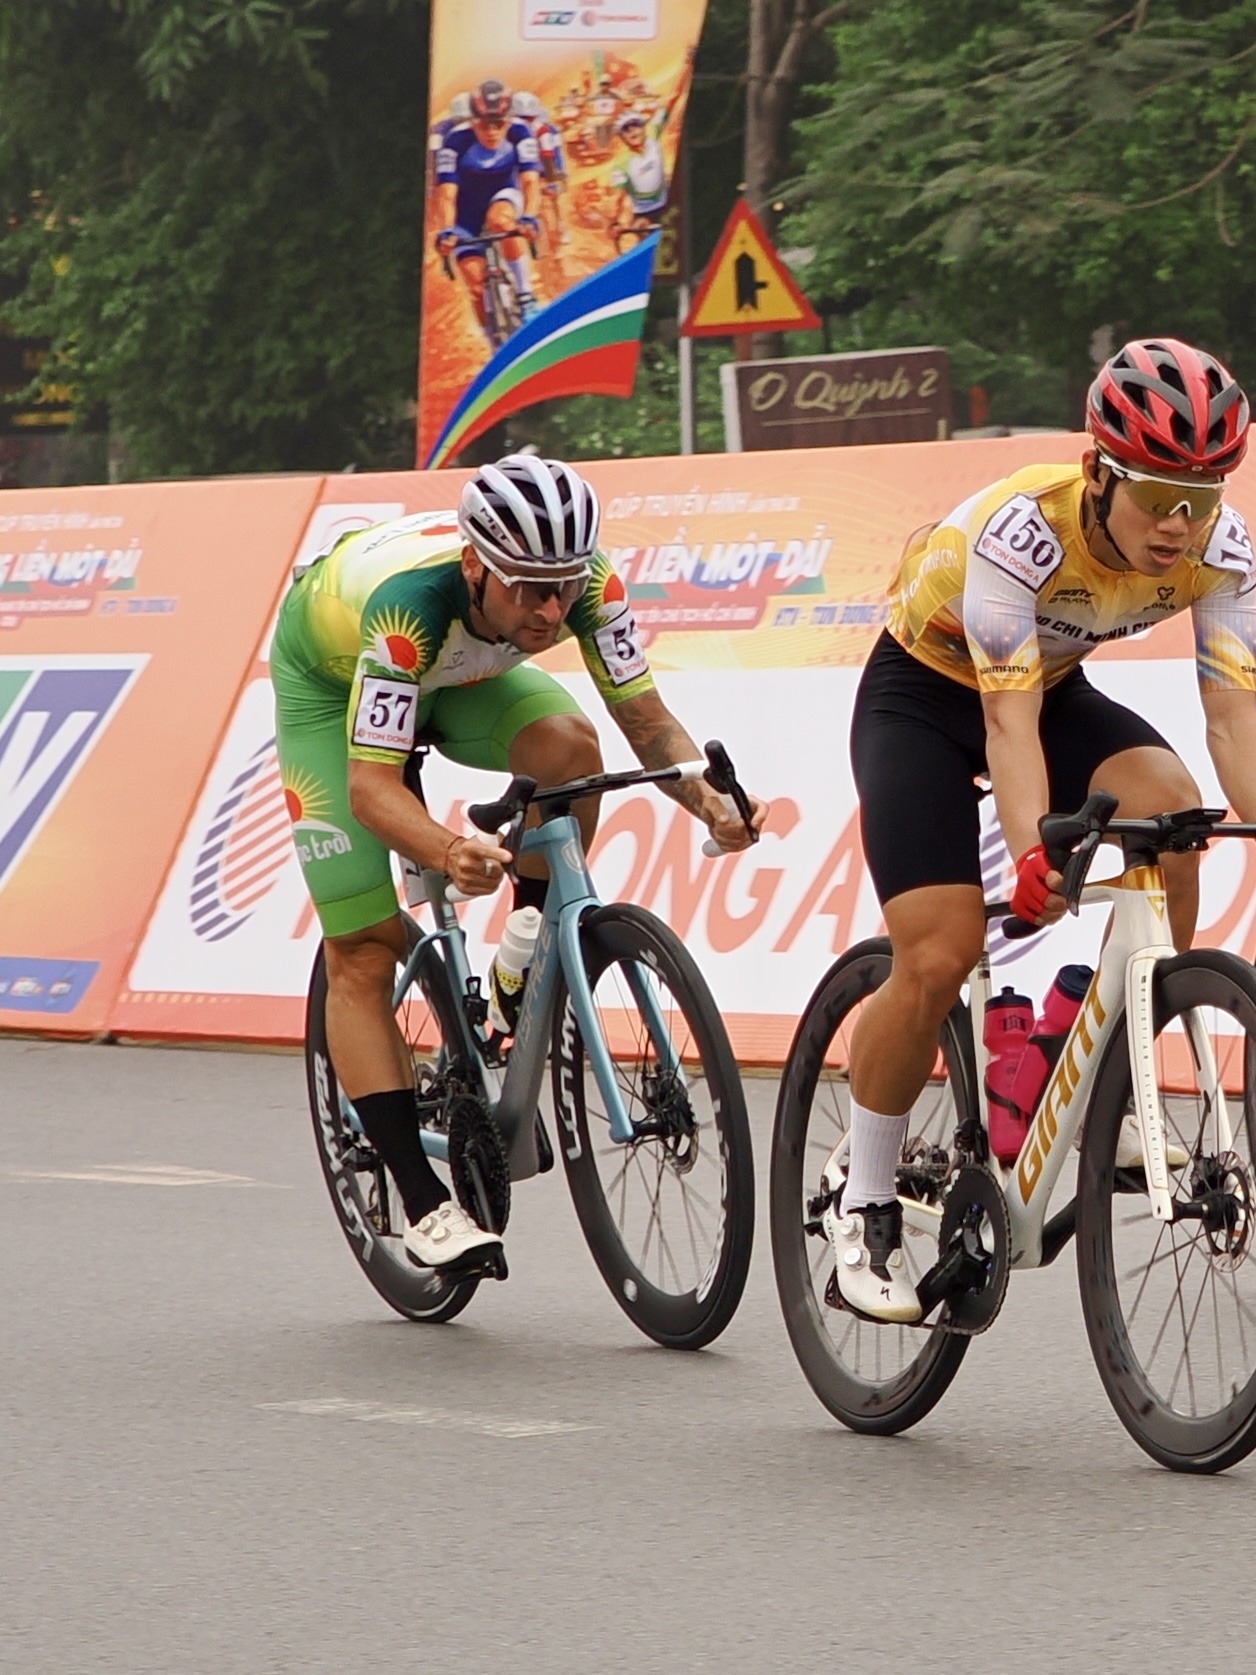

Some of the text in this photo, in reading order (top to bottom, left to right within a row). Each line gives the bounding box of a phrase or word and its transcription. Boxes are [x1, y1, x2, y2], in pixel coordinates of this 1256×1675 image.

[918, 367, 940, 397] 2
[990, 543, 1010, 561] TON
[1007, 556, 1035, 579] DONG
[1051, 620, 1083, 638] CHI
[1083, 626, 1128, 644] MINH
[369, 691, 413, 732] 57
[1017, 968, 1107, 1207] GIANT
